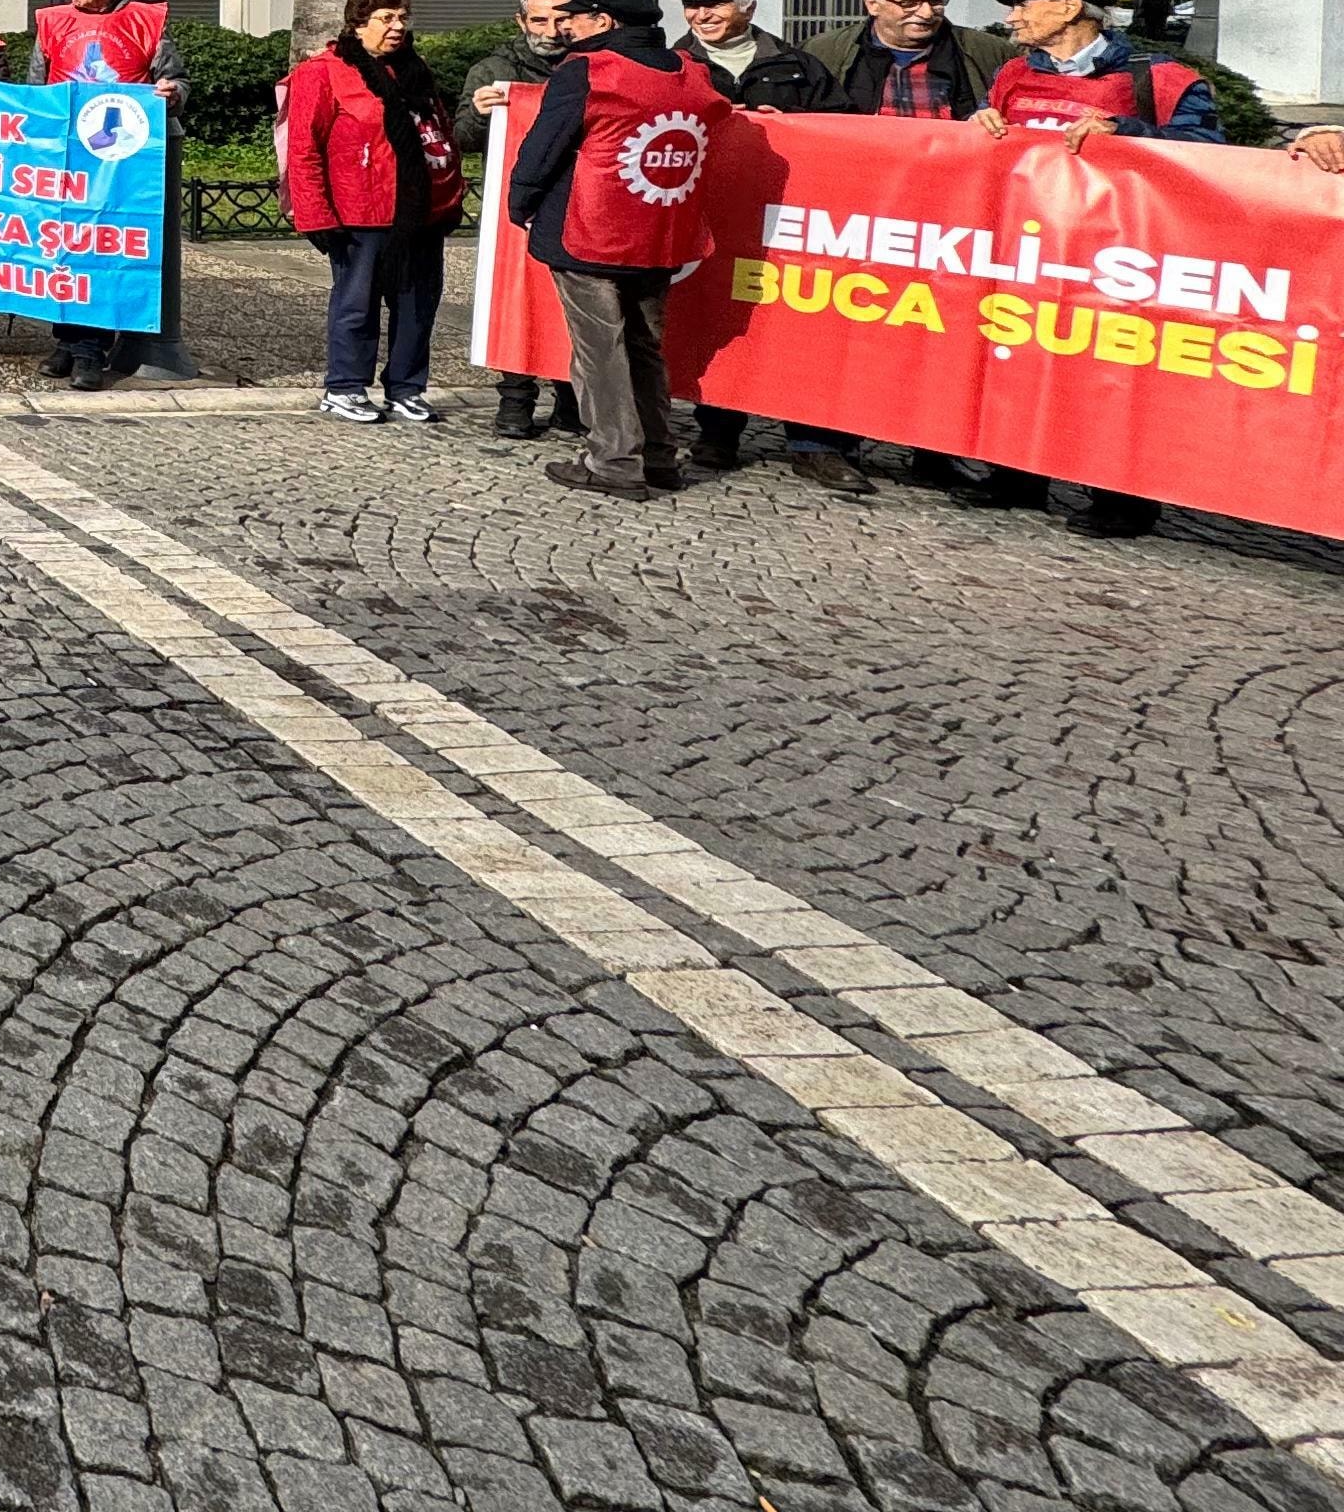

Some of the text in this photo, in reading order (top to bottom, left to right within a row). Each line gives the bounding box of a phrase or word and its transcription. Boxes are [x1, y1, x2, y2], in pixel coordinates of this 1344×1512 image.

[644, 144, 697, 169] DİSK
[12, 164, 89, 203] SEN
[38, 221, 149, 259] ŞUBE
[762, 204, 1291, 321] EMEKLİ-SEN
[730, 257, 1320, 396] BUCA ŞUBESİ
